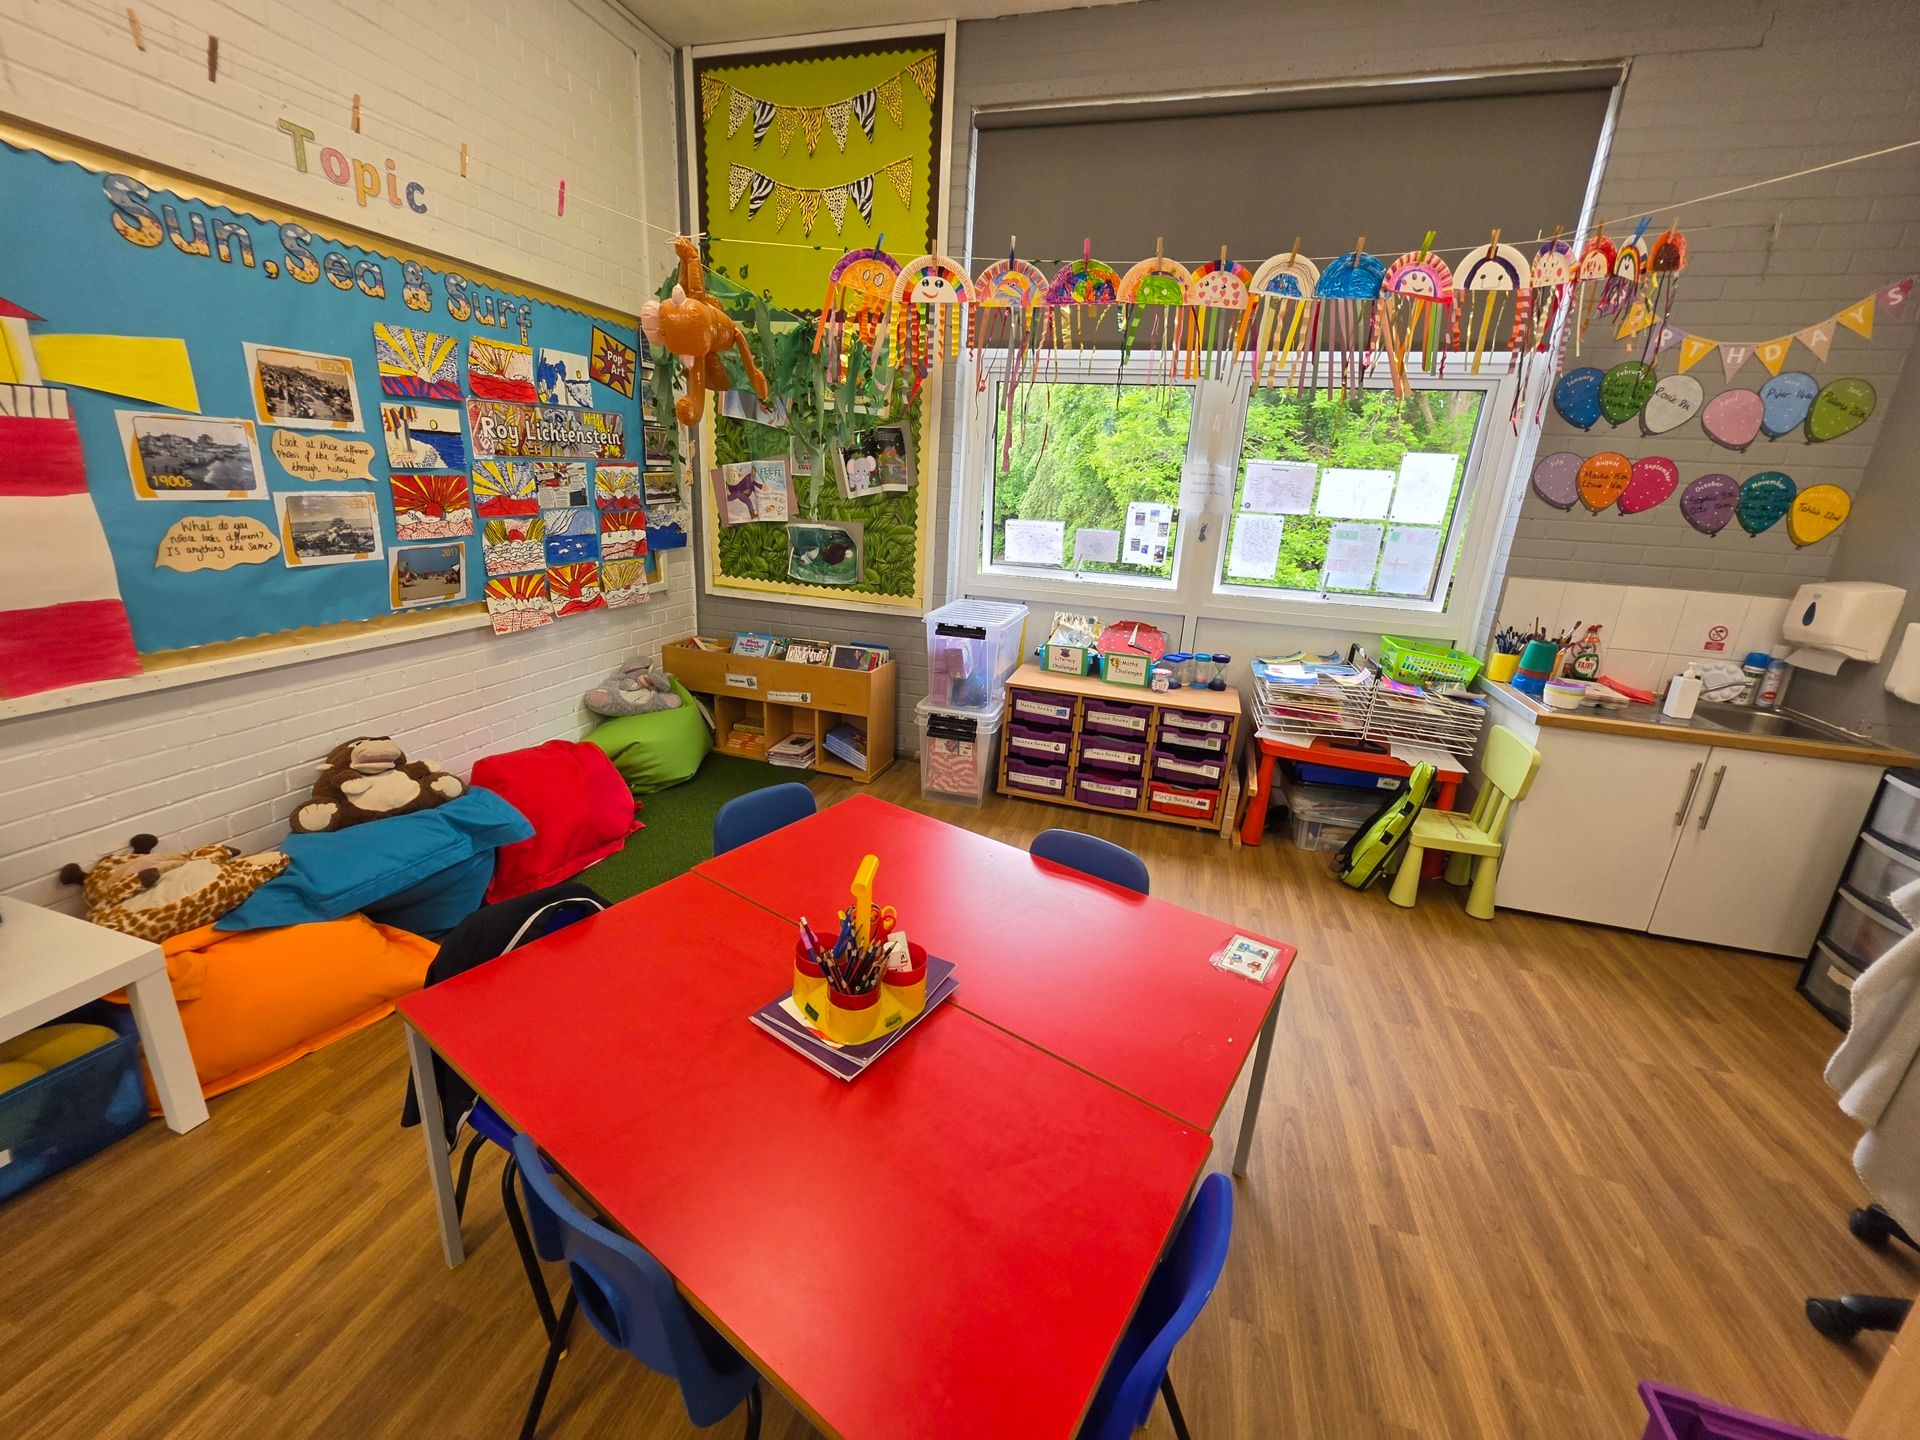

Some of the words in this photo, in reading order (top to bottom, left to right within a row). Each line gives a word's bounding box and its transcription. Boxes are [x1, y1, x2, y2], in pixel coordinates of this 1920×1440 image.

[278, 118, 428, 214] Topic
[401, 259, 433, 314] &
[444, 271, 532, 347] Surf
[607, 350, 624, 367] Pop
[610, 364, 626, 378] Art
[1566, 375, 1595, 388] January
[1655, 386, 1677, 404] Rosie
[481, 416, 519, 447] Roy
[525, 420, 622, 446] Lichtenstein
[279, 430, 299, 448] Look
[305, 440, 315, 449] at
[320, 440, 338, 451] these
[343, 444, 369, 456] different
[316, 452, 329, 460] the
[292, 461, 321, 479] through
[1595, 460, 1620, 468] August
[1644, 463, 1671, 482] September
[151, 474, 193, 488] 1900s
[1694, 481, 1725, 493] October
[1751, 480, 1787, 490] November
[181, 520, 214, 532] What
[218, 520, 229, 531] do
[233, 522, 248, 533] you
[225, 532, 264, 544] different?
[186, 544, 225, 561] anything
[229, 543, 244, 552] the
[1054, 655, 1076, 665] Literacy
[1577, 661, 1595, 670] FAIRY
[1052, 663, 1078, 672] Challenges
[1115, 668, 1143, 677] Challenges
[1020, 701, 1036, 709] Maths
